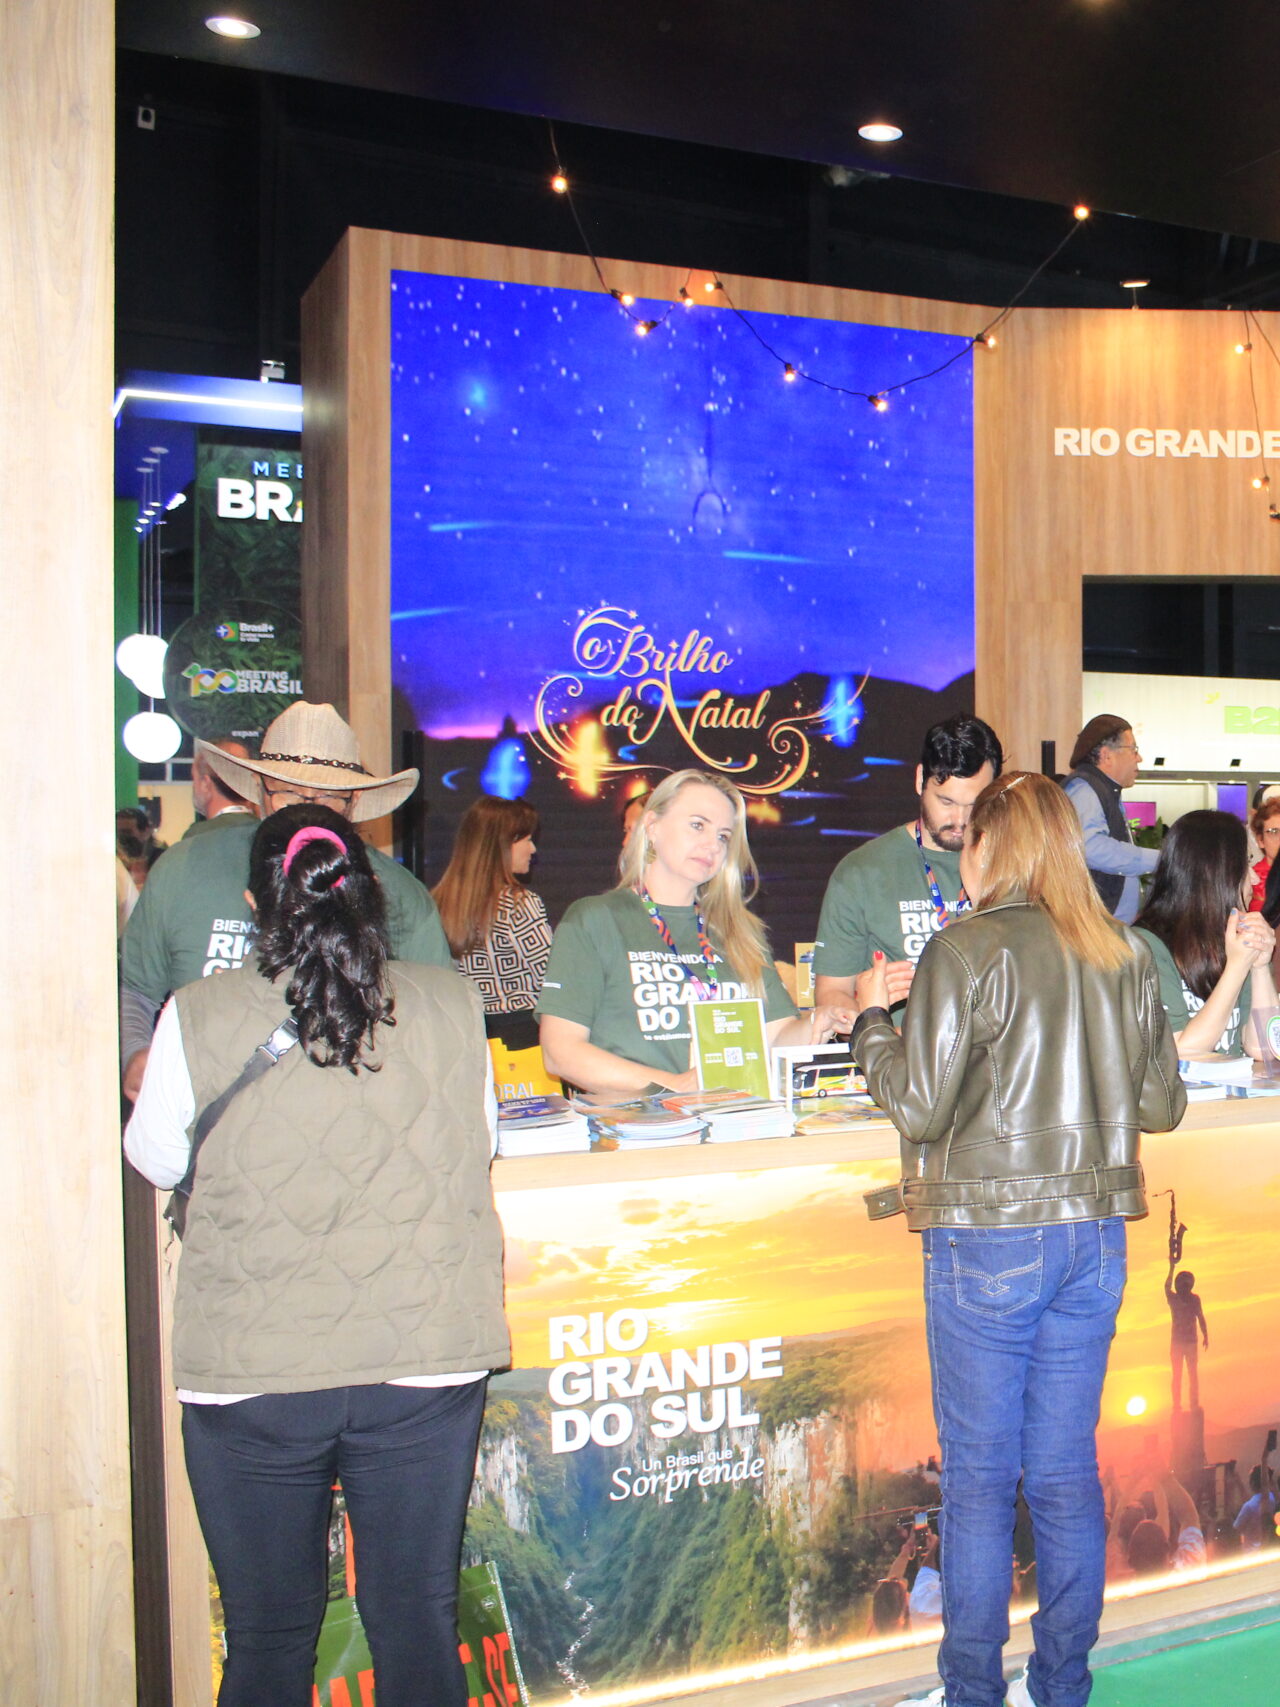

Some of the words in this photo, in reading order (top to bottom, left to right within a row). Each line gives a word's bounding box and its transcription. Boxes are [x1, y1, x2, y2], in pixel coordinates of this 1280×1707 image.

[1054, 427, 1120, 457] RIO
[619, 625, 734, 678] Brilho
[236, 680, 303, 695] BRASIL
[237, 670, 289, 681] MEETING
[600, 686, 644, 727] do
[903, 933, 933, 957] G
[630, 962, 685, 984] RIO
[637, 1006, 680, 1032] DO
[548, 1308, 649, 1360] RIO
[548, 1336, 783, 1407] GRANDE
[551, 1402, 634, 1454] DO
[650, 1386, 760, 1439] SUL
[609, 1445, 765, 1503] Sorprende
[642, 1459, 662, 1472] Un
[666, 1451, 704, 1469] Brasil
[707, 1449, 733, 1464] que
